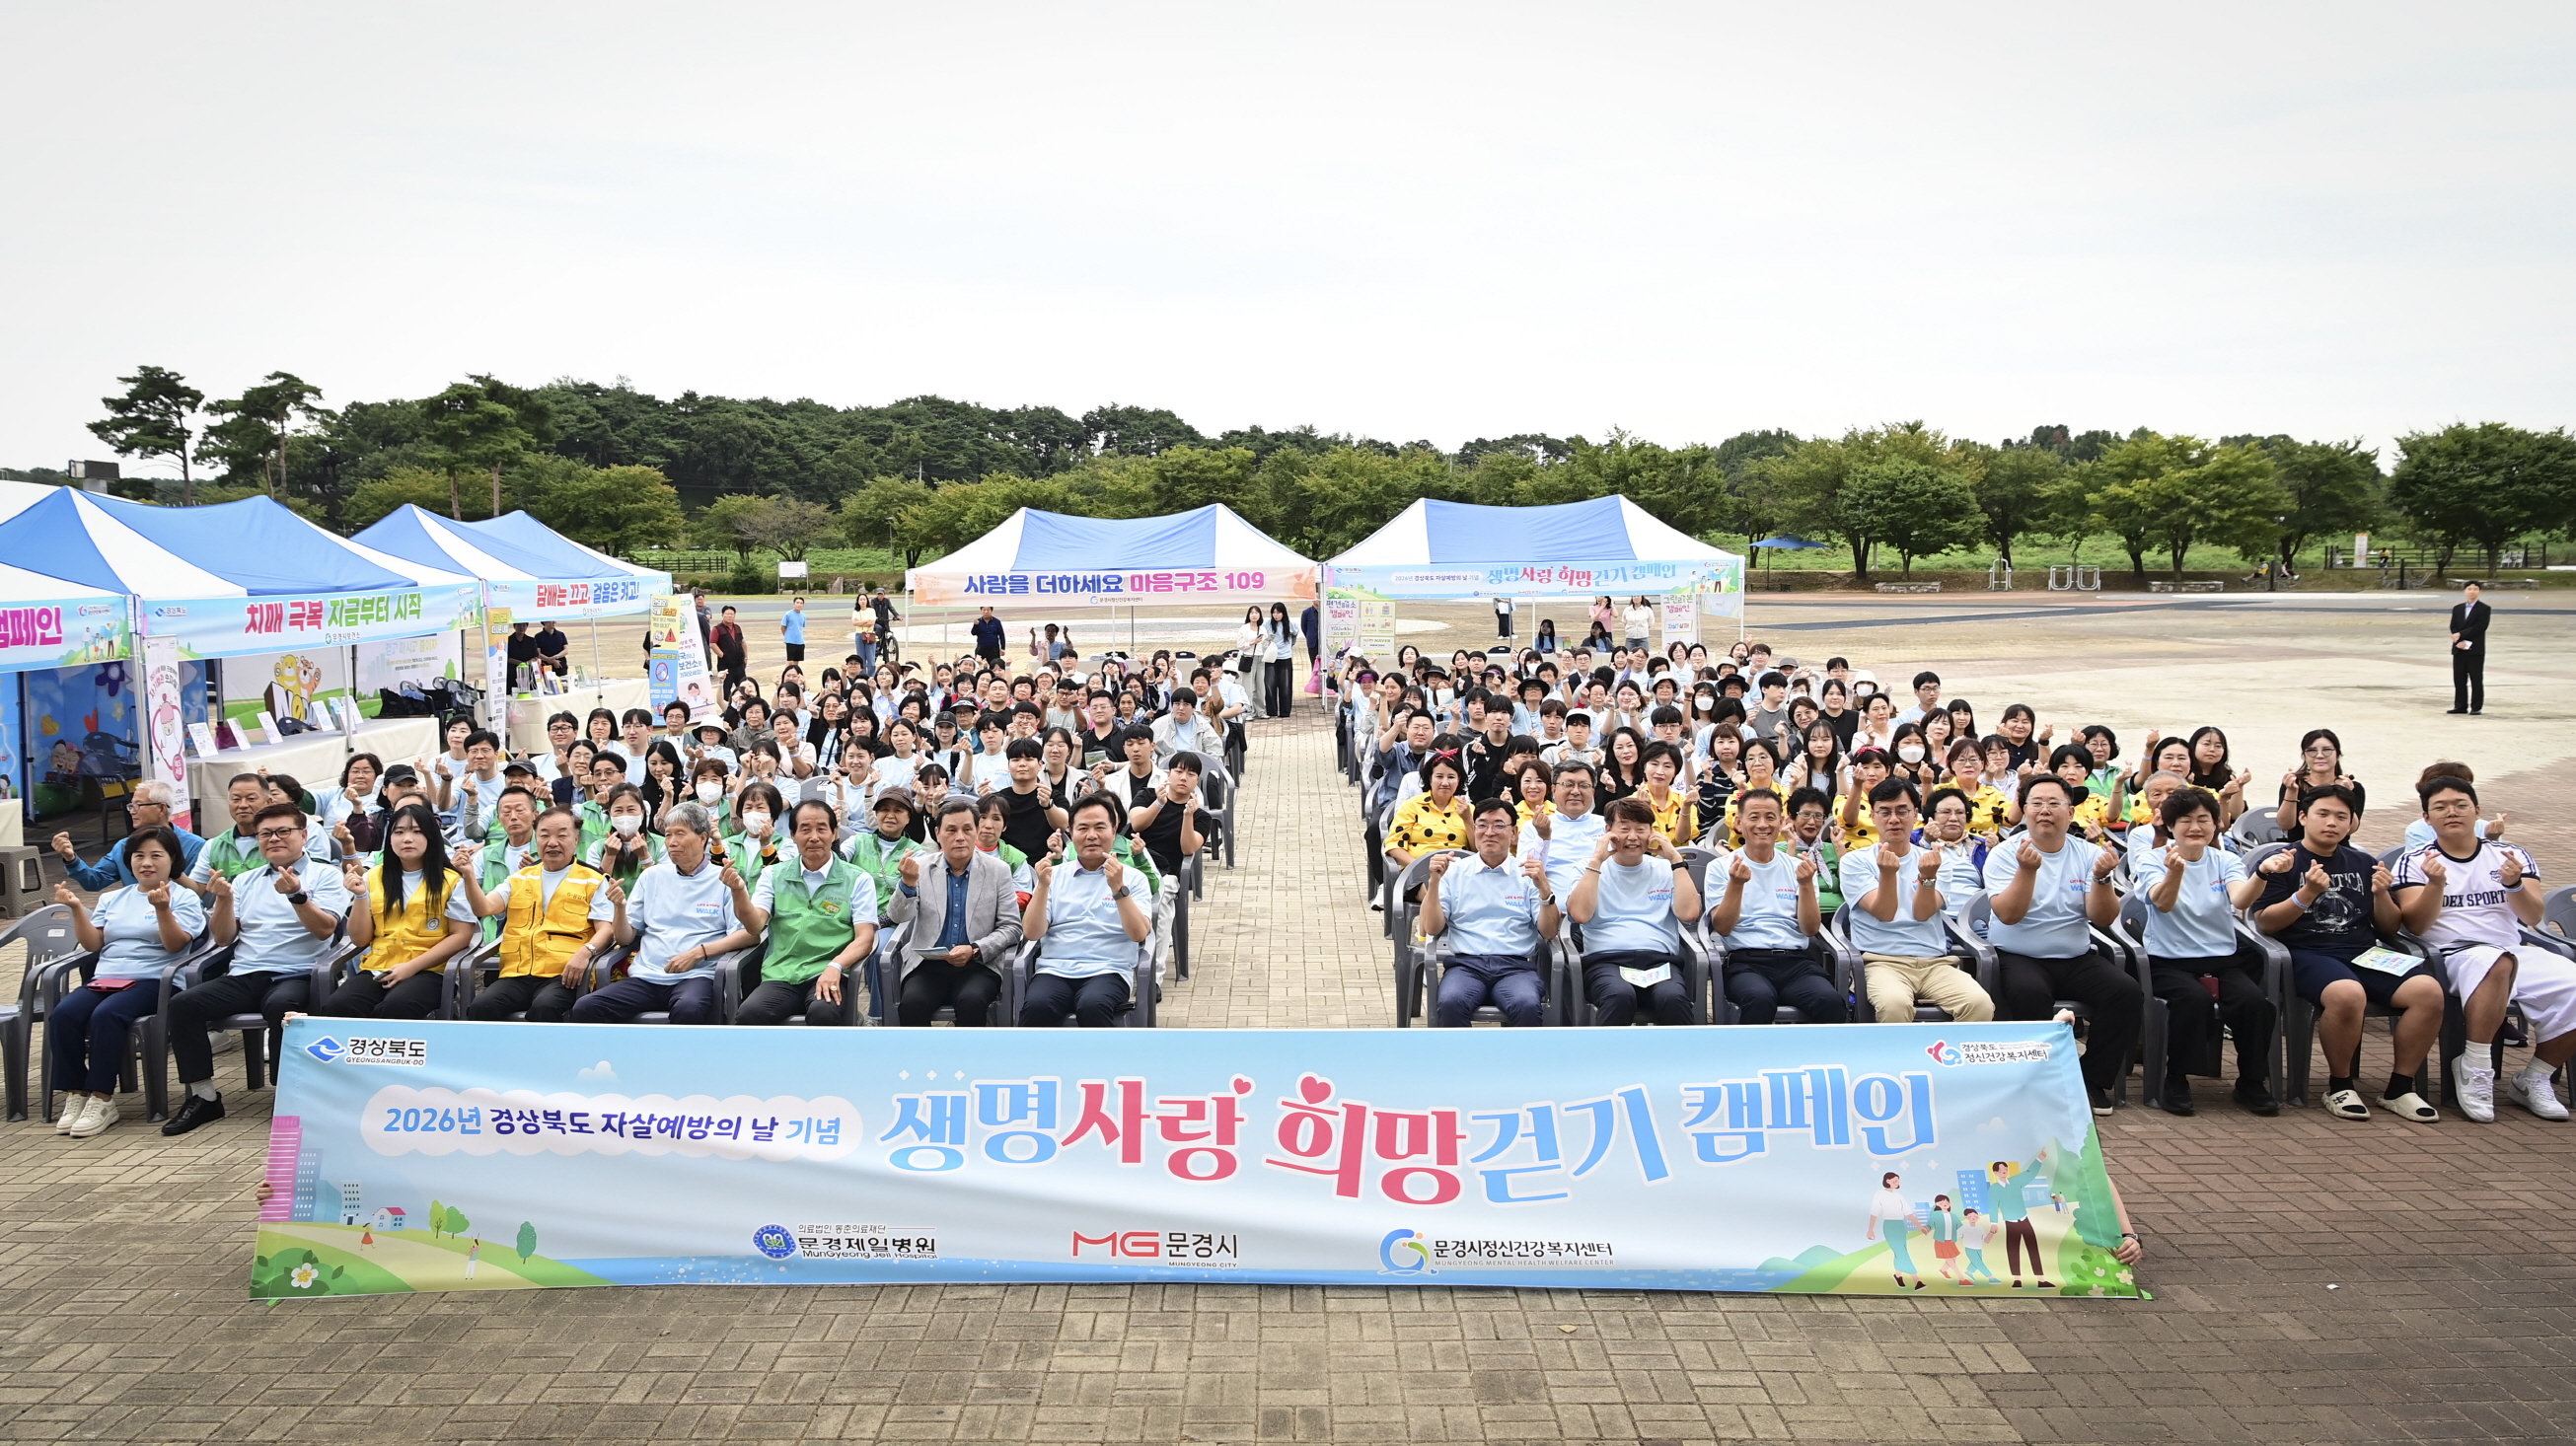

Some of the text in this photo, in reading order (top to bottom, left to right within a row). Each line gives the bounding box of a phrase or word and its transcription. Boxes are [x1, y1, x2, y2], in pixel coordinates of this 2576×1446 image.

[964, 571, 1265, 595] 사람을 더하세요 마음구조 109
[1487, 563, 1676, 587] 생명사랑 희망걷기 캠페인
[536, 584, 567, 608] 담배는
[568, 583, 591, 605] 끄고,
[593, 581, 619, 605] 걸음은
[1663, 594, 1693, 604] 그린리본
[245, 592, 422, 634] 치매 극복 지금부터 시작
[1329, 609, 1354, 618] 캠페인
[1666, 605, 1690, 614] 캠페인
[332, 632, 361, 643] 문경시보건소
[2298, 872, 2365, 896] ANTICA
[2442, 889, 2510, 907] DEX SPORT
[349, 1039, 425, 1057] 경상북도
[1964, 1049, 2048, 1063] 정신건강복지센터
[346, 1056, 424, 1065] GYEONGSANGBUK-DO
[383, 1106, 841, 1145] 2026년 경상북도 자살예방의 날 기념
[879, 1065, 1937, 1205] 생명사랑 희망걷기 캠페인
[798, 1224, 832, 1234] 의료법인
[798, 1237, 936, 1254] 문경제일병원
[1072, 1231, 1237, 1259] MG 문경시
[1434, 1240, 1613, 1258] 문경시정신건강복지센터
[802, 1250, 870, 1260] MunGyeong
